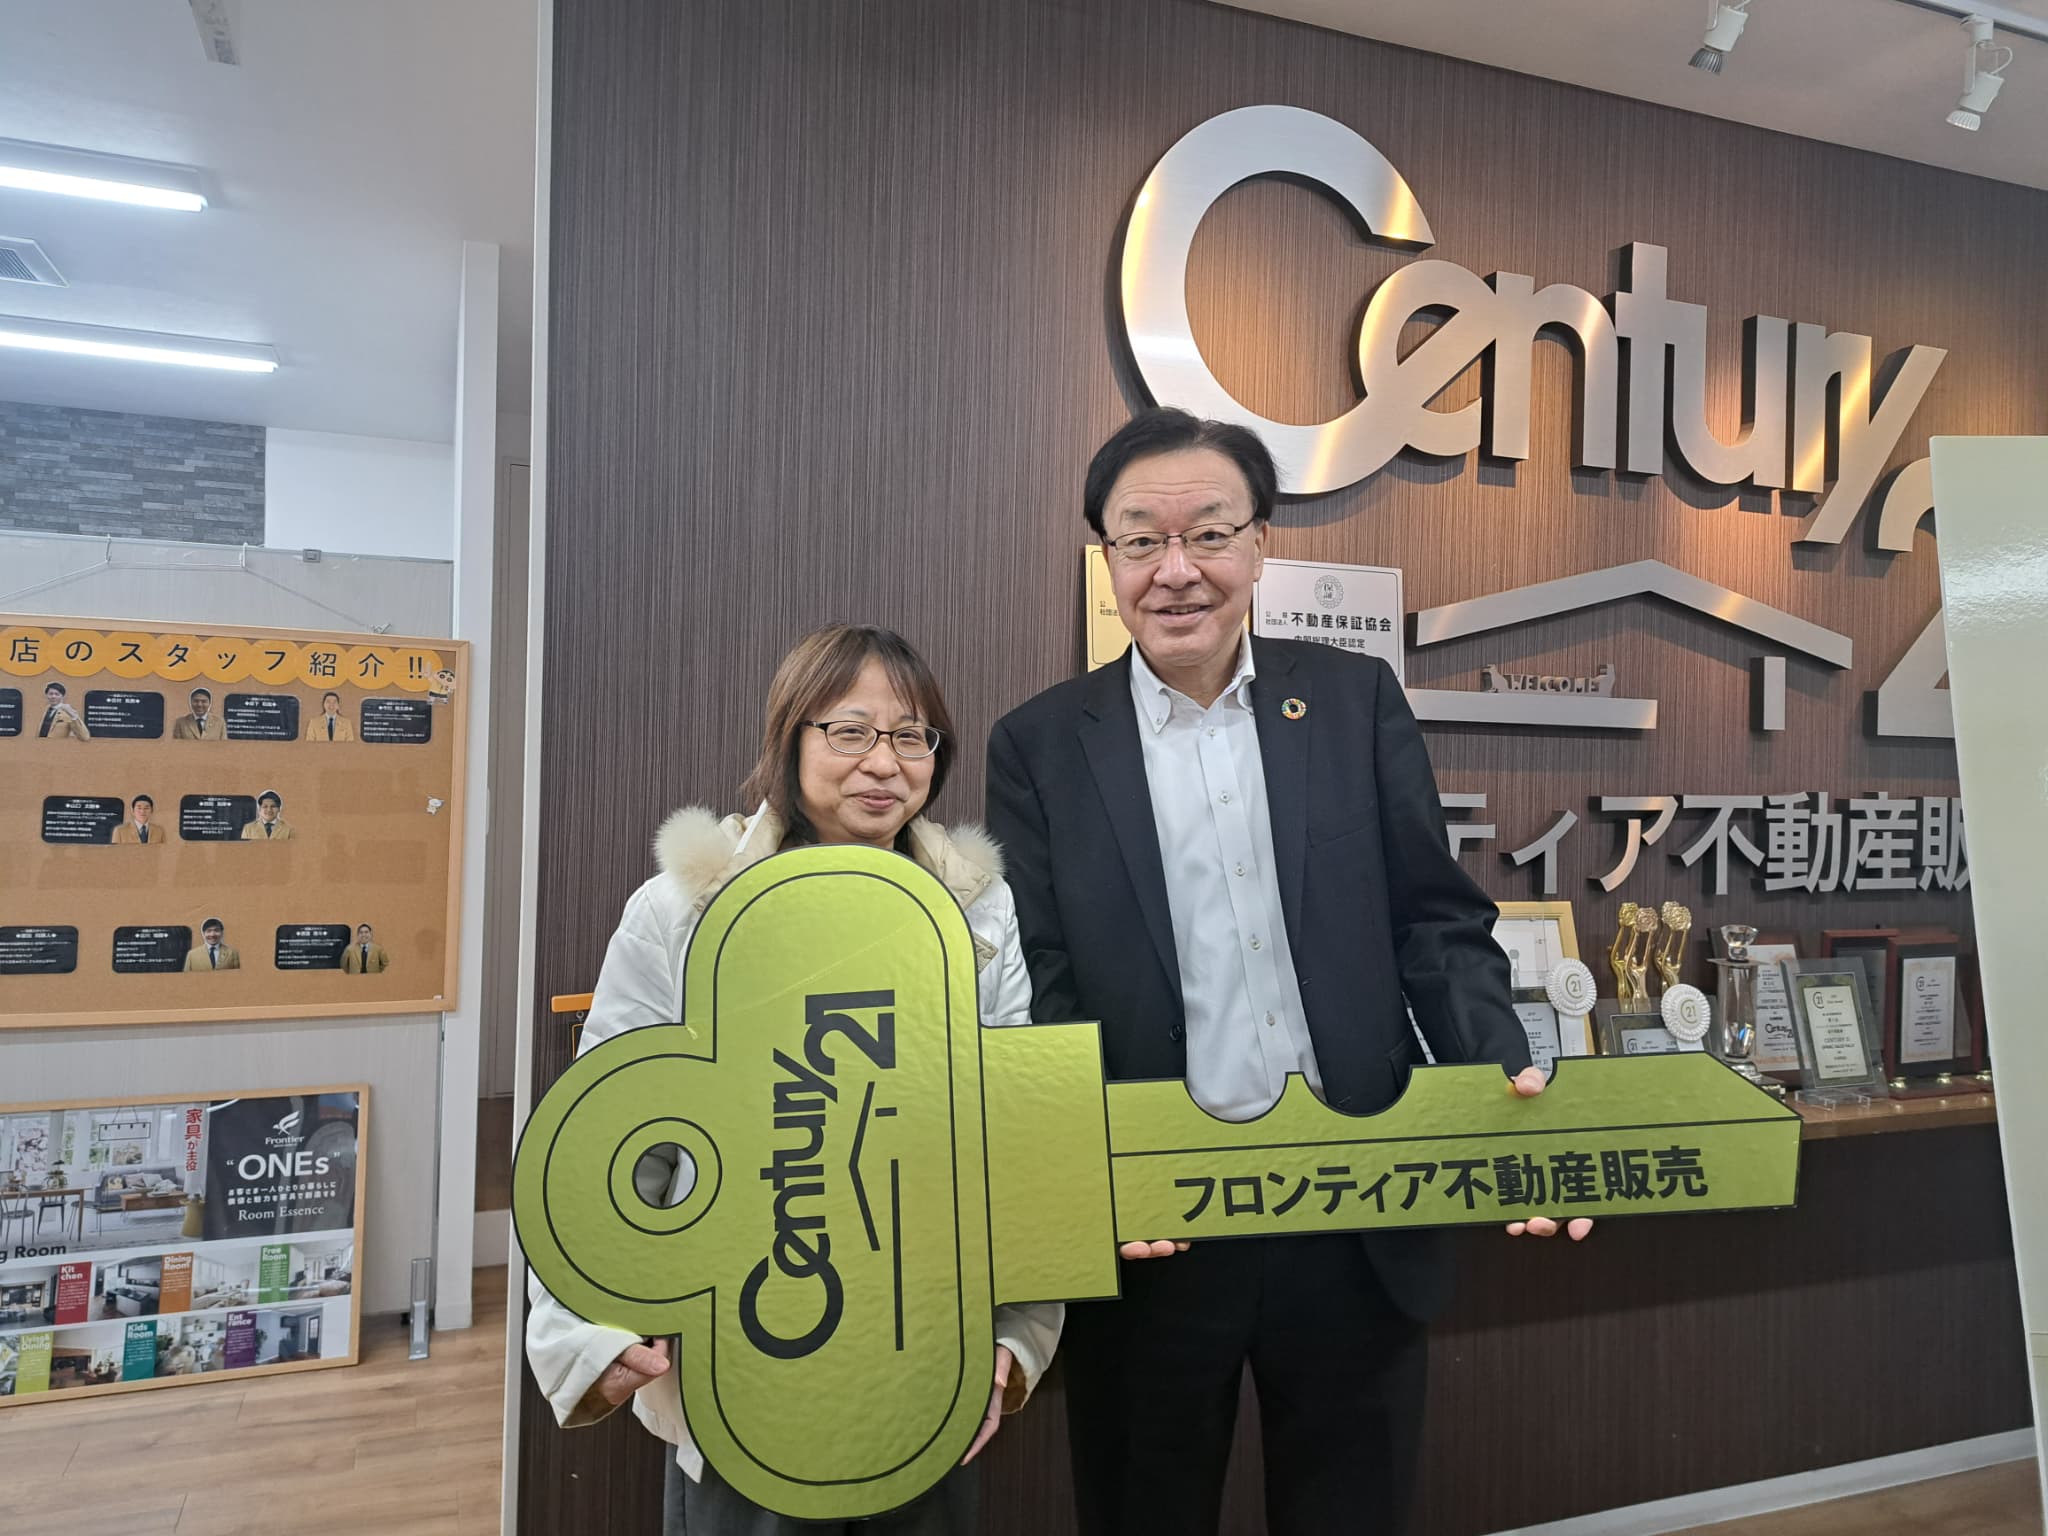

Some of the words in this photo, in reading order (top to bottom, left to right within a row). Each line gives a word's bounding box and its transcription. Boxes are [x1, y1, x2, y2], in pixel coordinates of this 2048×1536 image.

[1121, 104, 1949, 545] Century
[1291, 611, 1392, 632] 不動産保証協会
[1503, 674, 1601, 693] WELCOME
[184, 1108, 203, 1172] 家具が主役
[265, 1135, 305, 1146] Frontier
[1173, 1145, 1709, 1223] フロンティア不動産販売
[738, 1047, 844, 1360] Century
[238, 1209, 275, 1221] Room
[279, 1206, 325, 1217] Essence
[14, 1244, 67, 1259] Room
[60, 1265, 76, 1275] Kit
[60, 1272, 83, 1281] chen
[127, 1323, 149, 1331] Kids
[127, 1330, 154, 1339] Room
